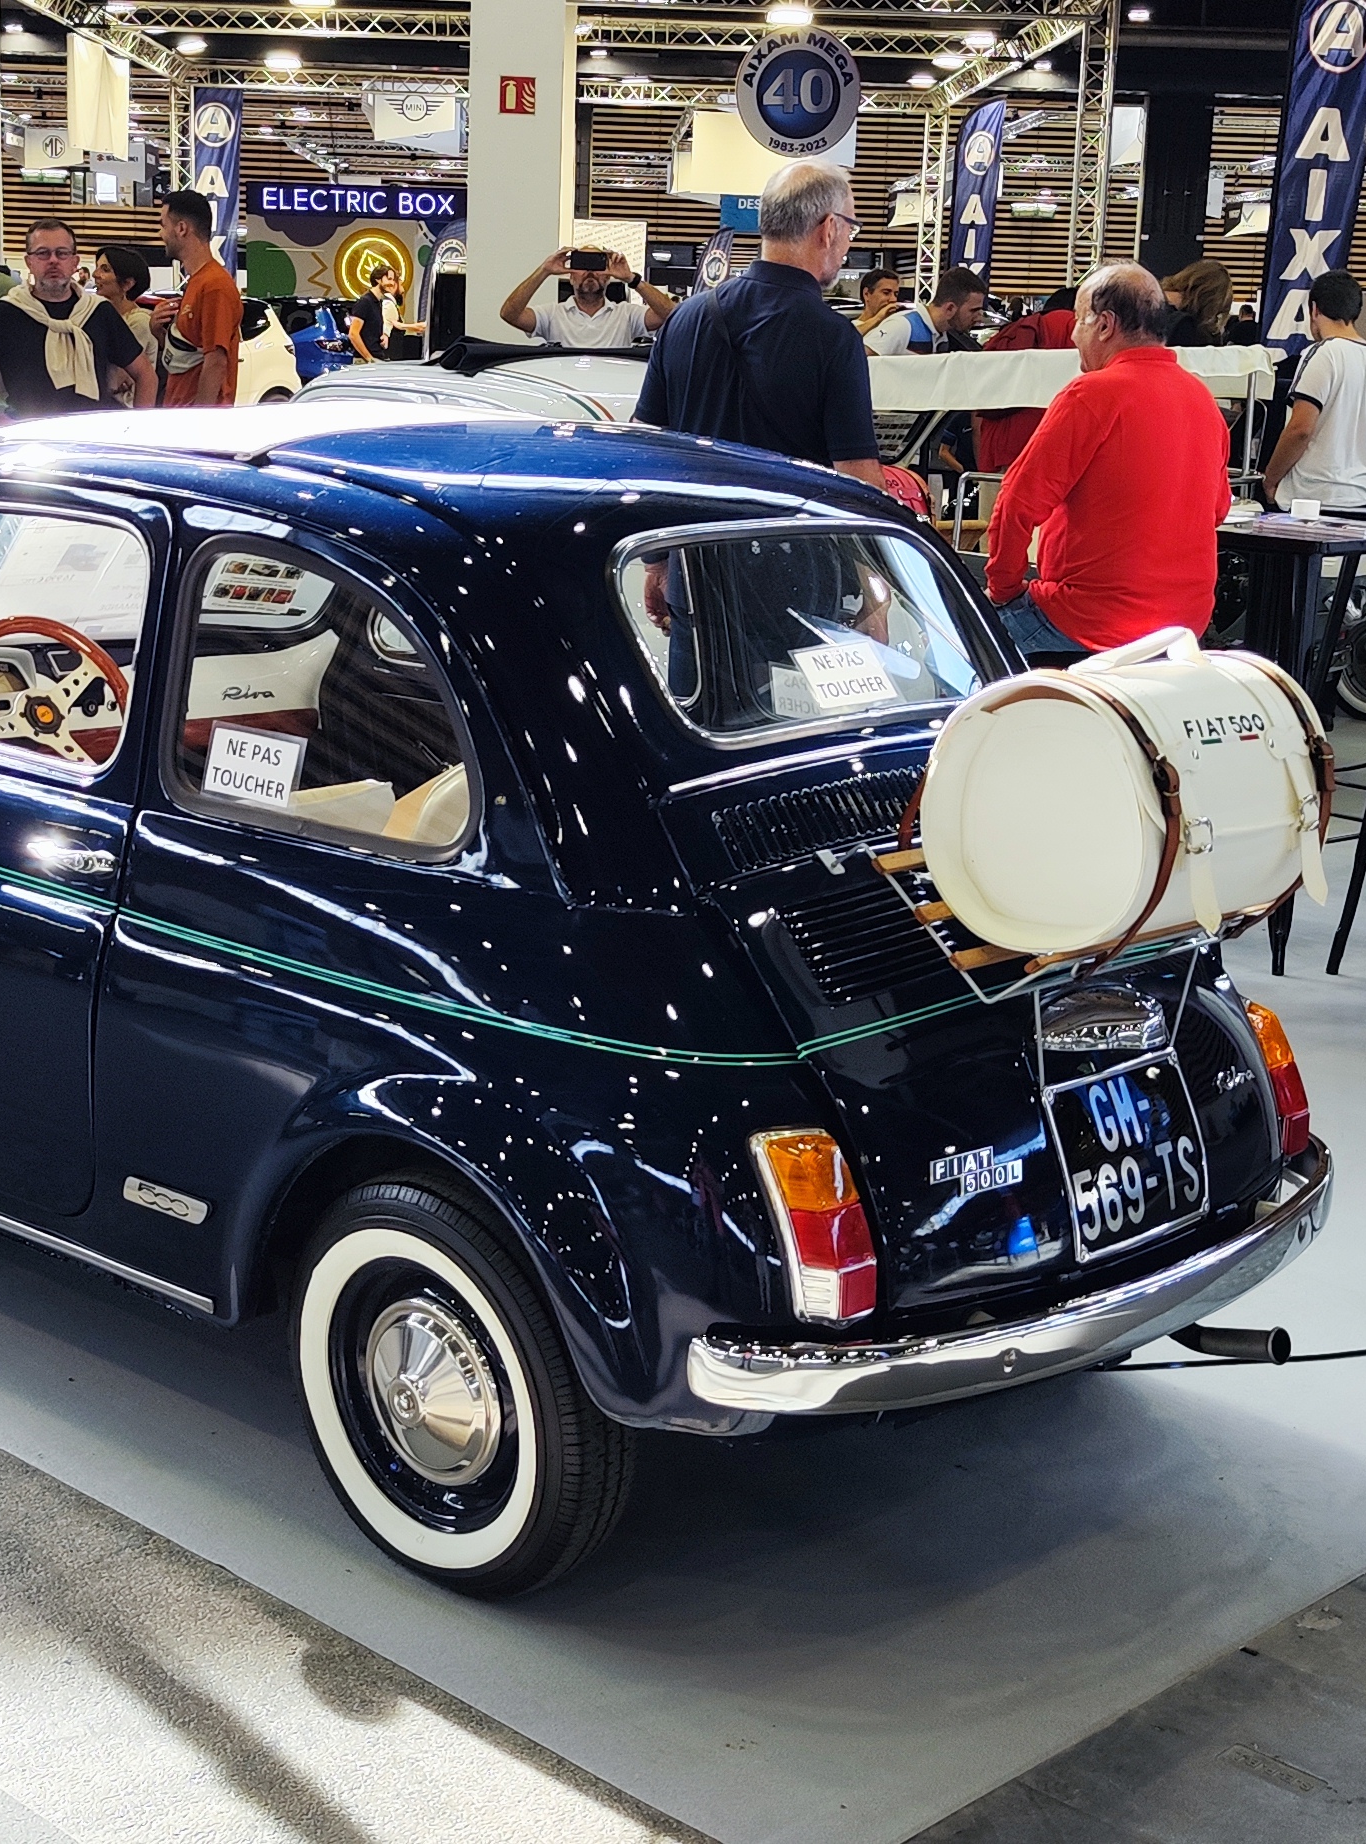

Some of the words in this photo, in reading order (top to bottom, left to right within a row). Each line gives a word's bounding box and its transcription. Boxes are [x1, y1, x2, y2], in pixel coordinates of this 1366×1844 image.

[742, 31, 800, 89] AIXAM
[806, 32, 855, 88] MEGA
[762, 68, 834, 114] 40
[405, 102, 425, 112] MINI
[44, 137, 64, 156] MG
[768, 136, 828, 153] 1983-2023
[262, 186, 388, 214] ELECTRIC
[398, 192, 455, 216] BOX
[811, 654, 835, 671] NE
[835, 650, 865, 668] PAS
[221, 684, 276, 702] Riva
[816, 676, 888, 699] TOUCHER
[1183, 716, 1228, 739] FIAT
[1231, 713, 1266, 735] 500
[226, 738, 248, 758] NE
[251, 744, 283, 767] PAS
[211, 766, 286, 801] TOUCHER
[1088, 1076, 1150, 1152] GM-
[934, 1149, 992, 1181] FIAT
[964, 1161, 1022, 1193] 500L
[137, 1181, 190, 1218] 500
[1072, 1135, 1201, 1241] 569-TS
